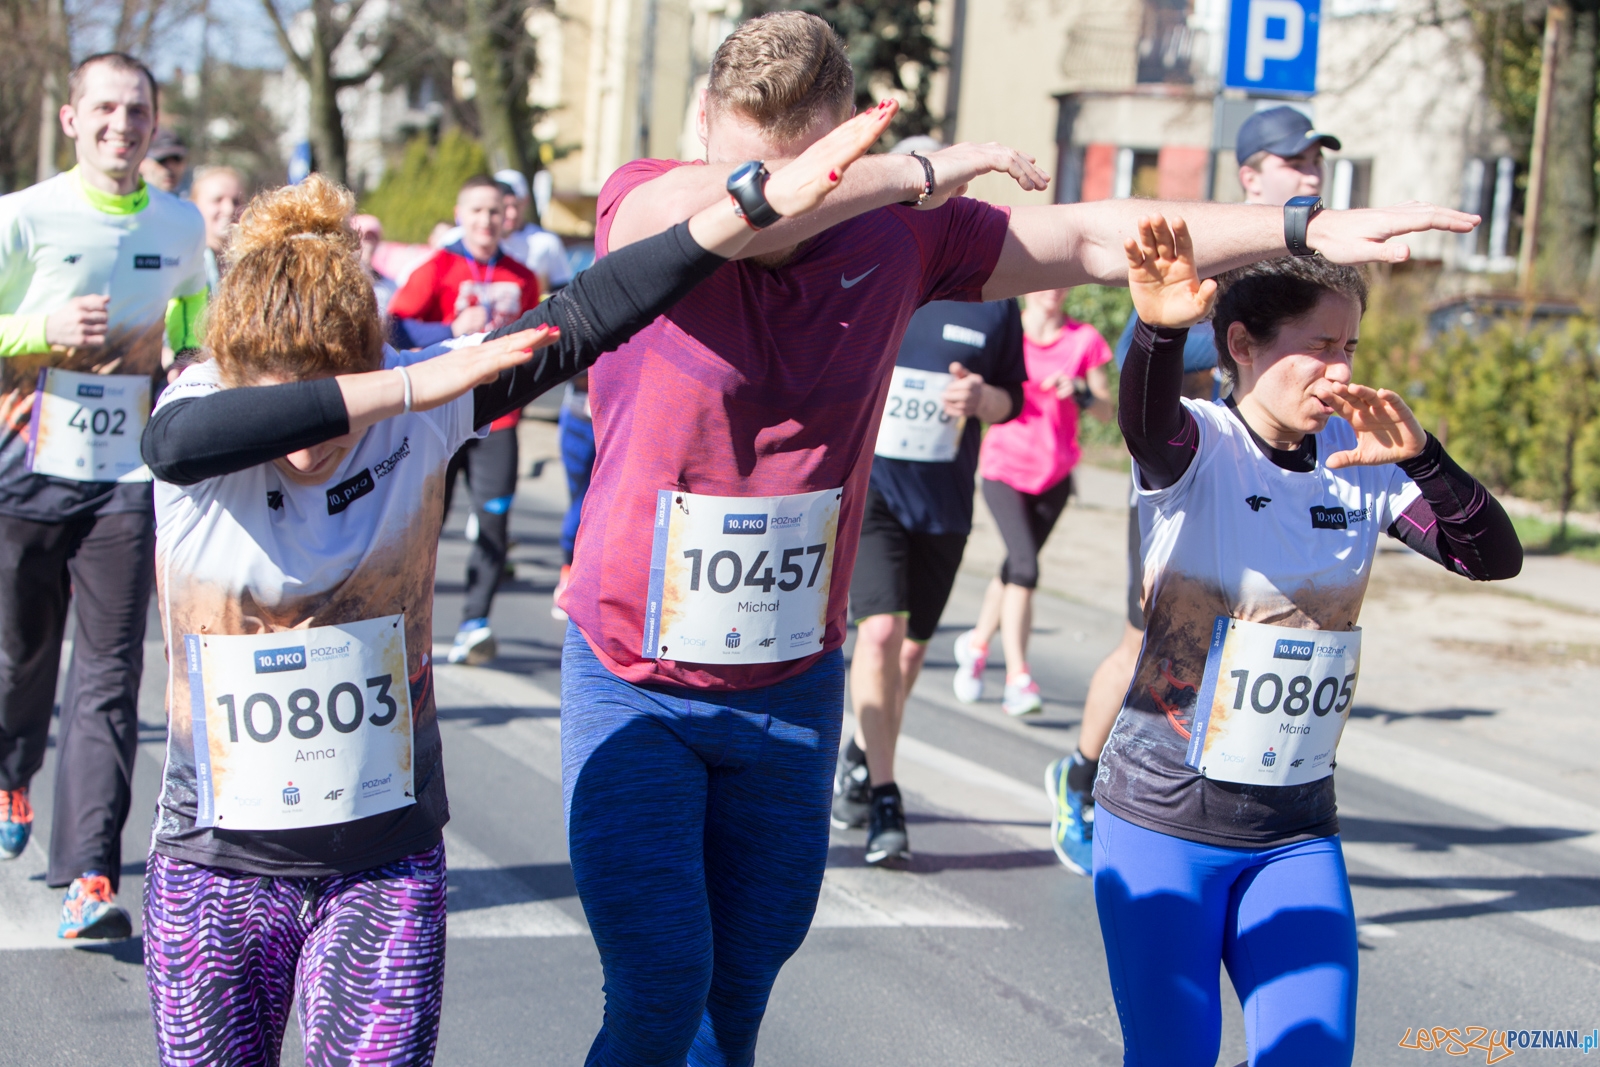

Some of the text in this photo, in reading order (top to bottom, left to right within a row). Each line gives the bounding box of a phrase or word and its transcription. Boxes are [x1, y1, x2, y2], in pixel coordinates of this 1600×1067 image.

[1243, 0, 1306, 82] P
[68, 406, 127, 436] 402
[343, 477, 368, 500] PKO
[658, 496, 666, 527] 26.03.2017
[728, 519, 764, 529] 10. PKO
[683, 542, 827, 594] 10457
[737, 599, 780, 613] Michał
[1213, 619, 1223, 647] 26.03.2017
[189, 638, 199, 672] 26.03.2017
[259, 652, 303, 667] 10. PKO
[1279, 644, 1311, 656] 10. PKO
[1230, 669, 1357, 717] 10805
[216, 673, 397, 743] 10803
[1279, 723, 1311, 735] Maria
[294, 748, 336, 763] Anna
